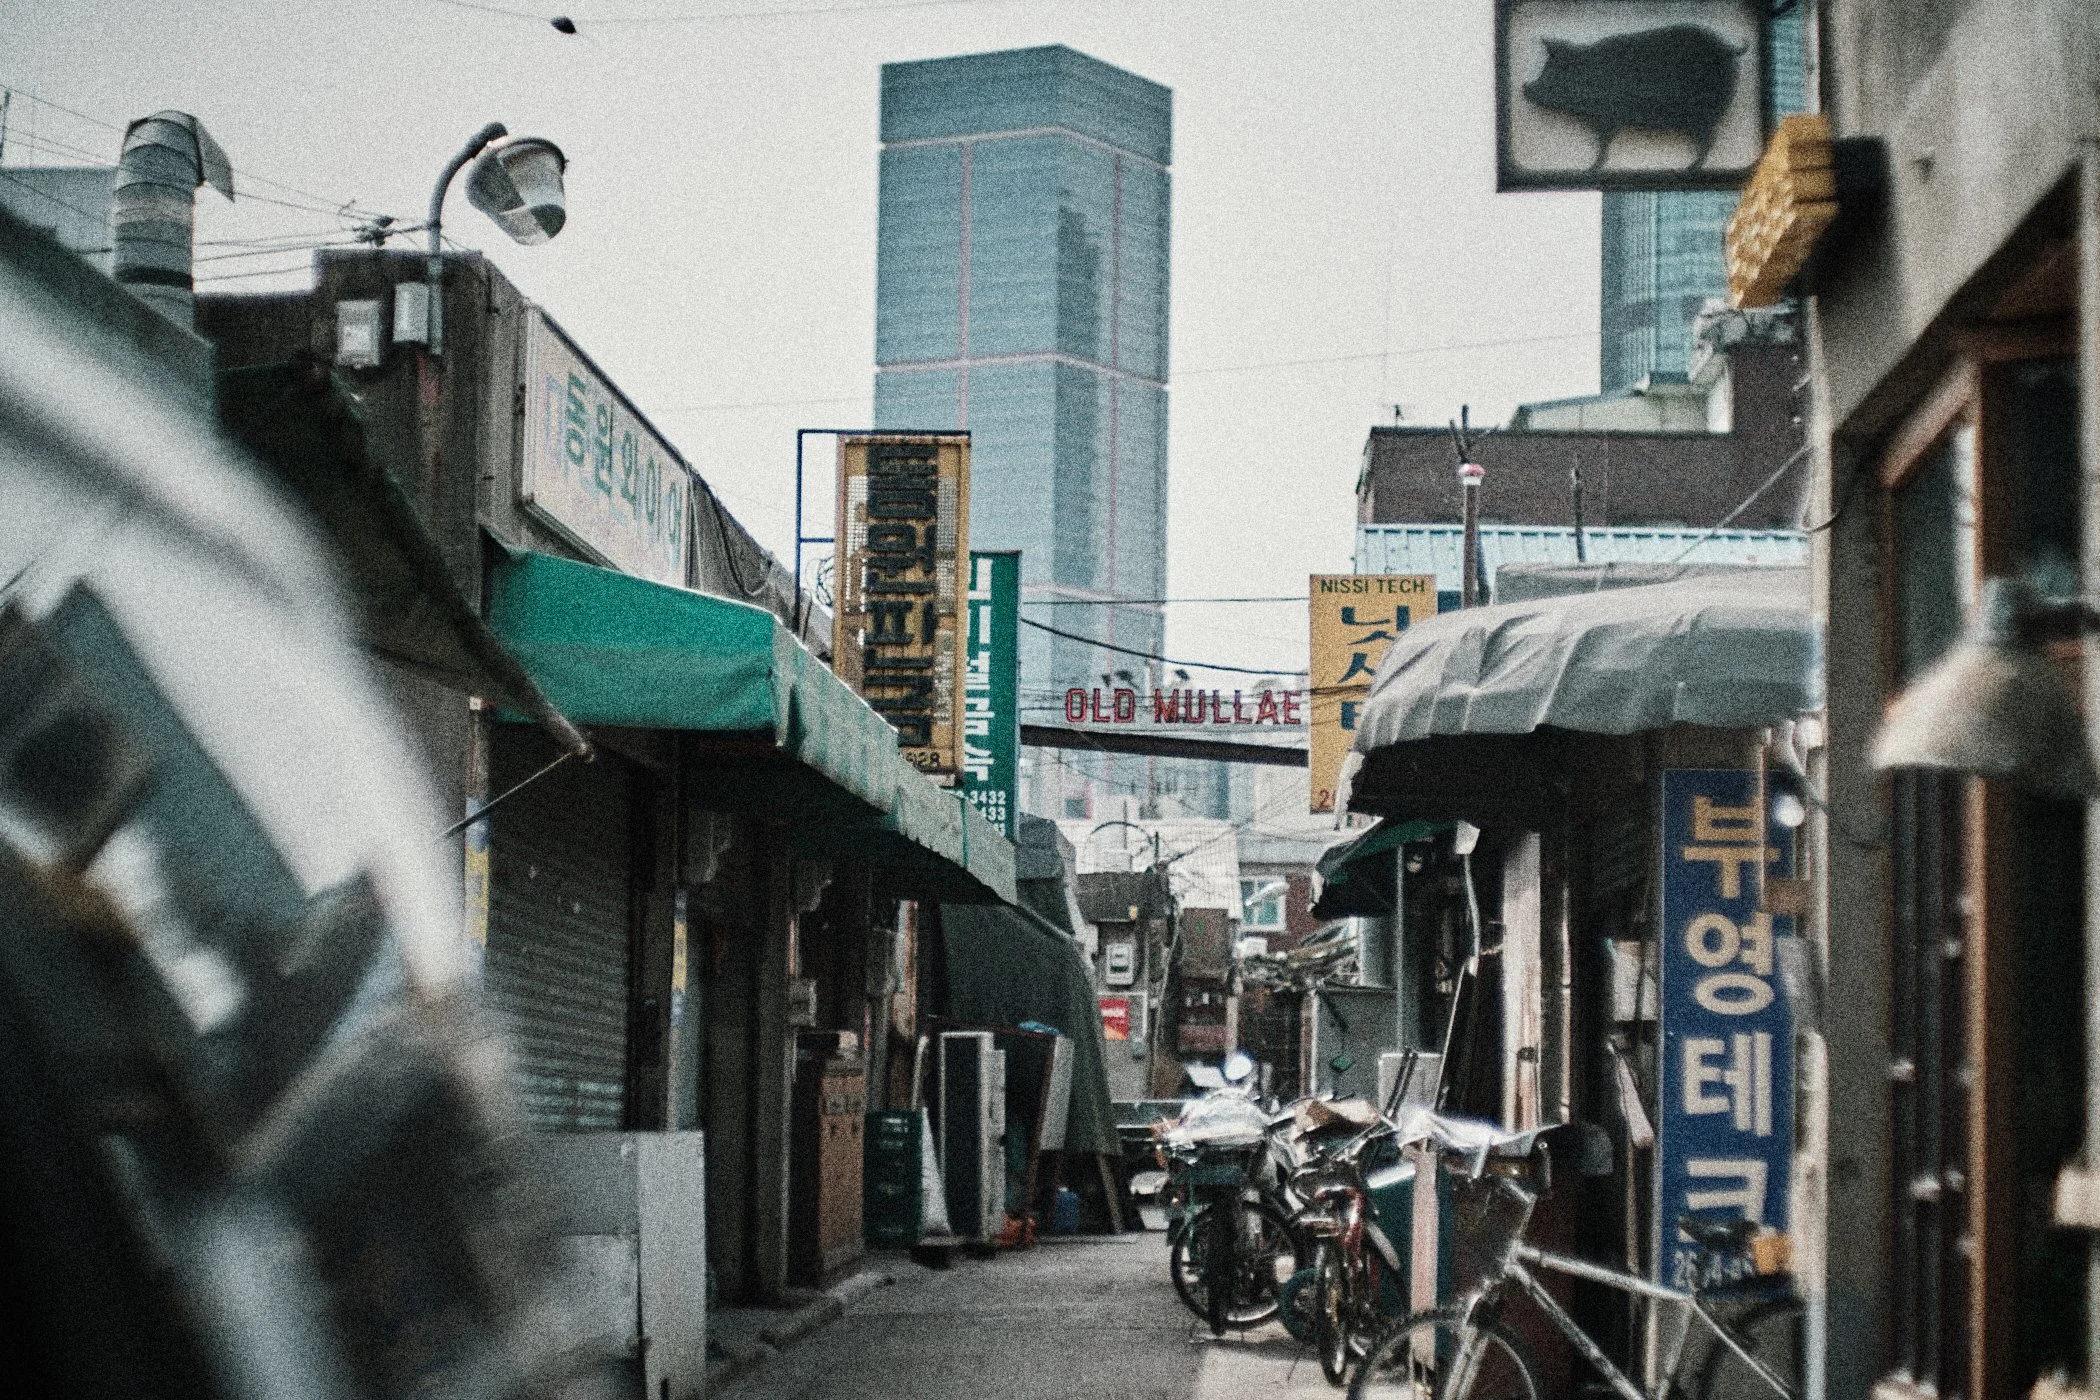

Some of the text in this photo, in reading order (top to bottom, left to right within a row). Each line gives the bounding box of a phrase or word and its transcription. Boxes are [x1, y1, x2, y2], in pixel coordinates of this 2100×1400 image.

[1321, 579, 1425, 593] NISSI TECH
[1066, 688, 1300, 724] OLD MULLAE
[1679, 796, 1780, 1235] 부영테크
